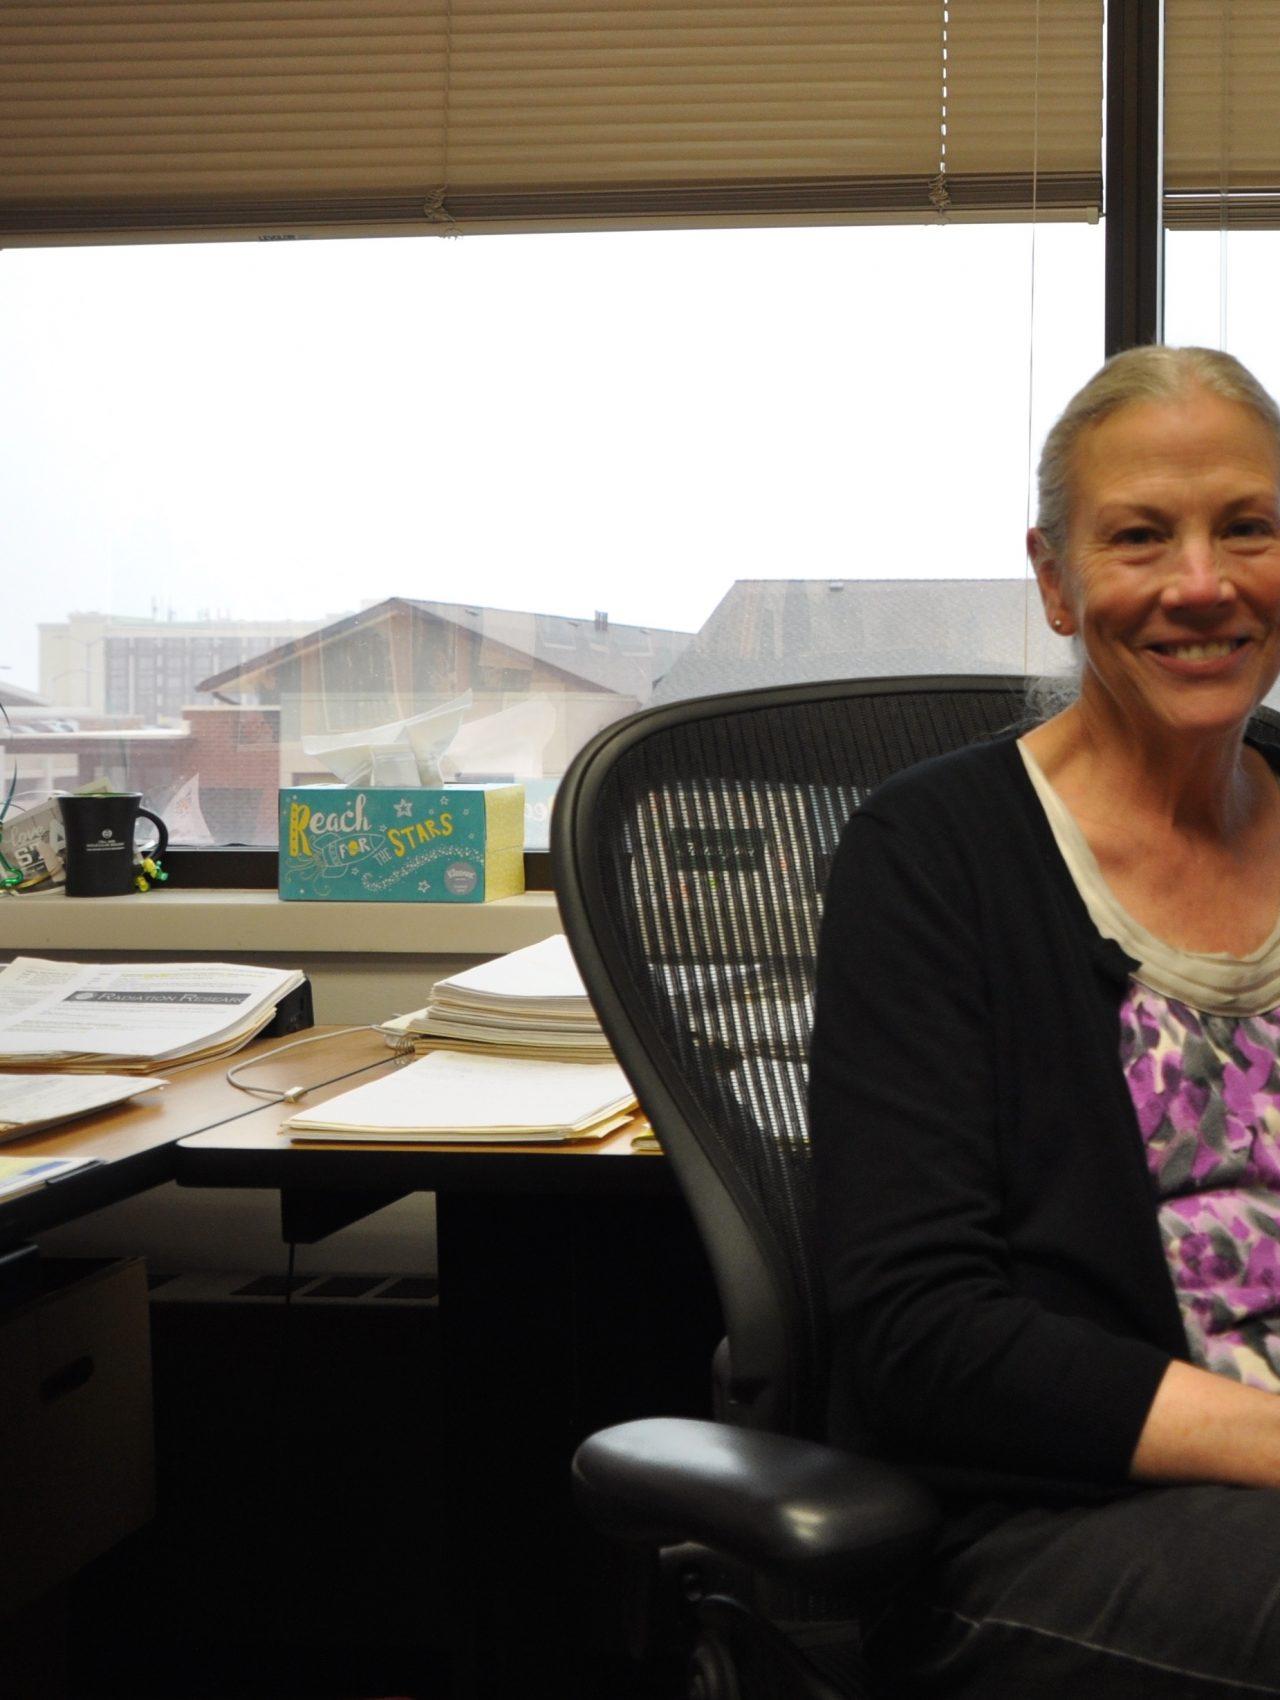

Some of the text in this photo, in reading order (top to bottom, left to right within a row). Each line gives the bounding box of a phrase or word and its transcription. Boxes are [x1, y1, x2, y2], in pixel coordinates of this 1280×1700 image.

[289, 793, 372, 857] Reach
[338, 812, 453, 867] FOR THE STARS
